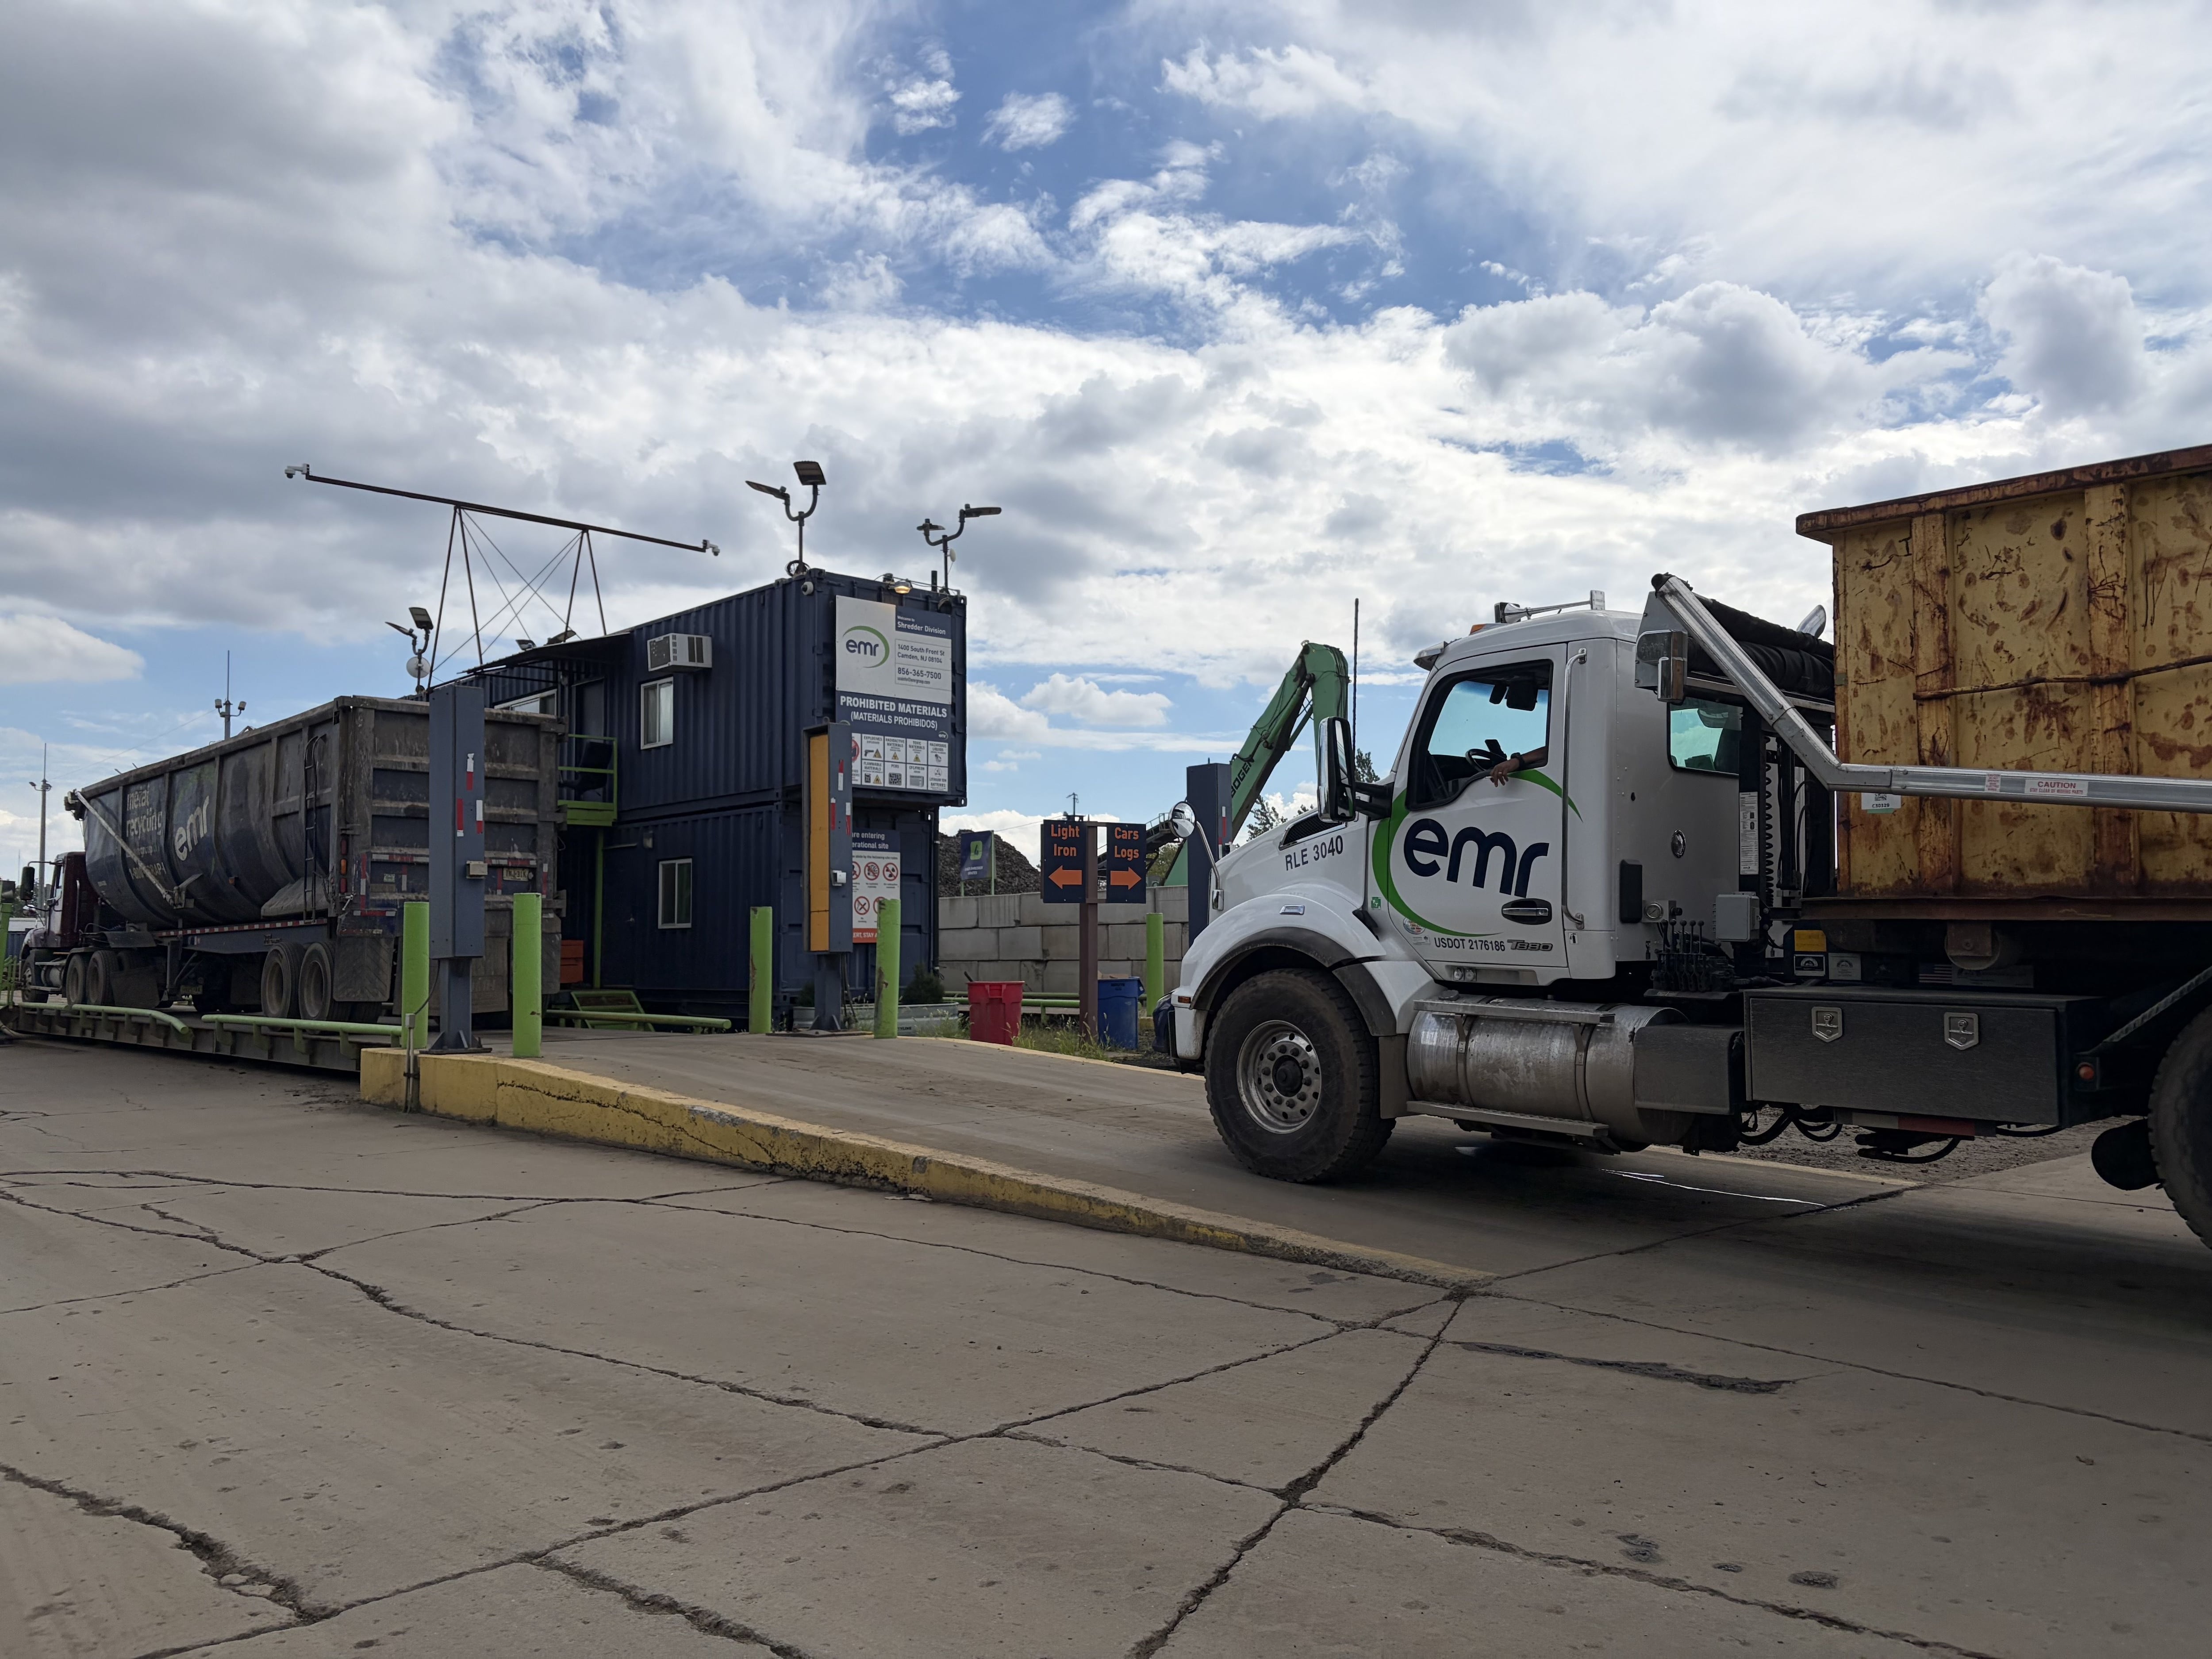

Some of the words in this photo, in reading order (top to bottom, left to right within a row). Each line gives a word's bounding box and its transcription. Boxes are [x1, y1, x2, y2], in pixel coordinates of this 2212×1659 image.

[897, 621, 923, 631] Shredder
[925, 626, 945, 635] Division
[846, 639, 879, 657] emr
[898, 652, 919, 661] Camden,
[898, 667, 941, 679] 856-365-7500
[840, 695, 896, 712] PROHIBITED
[898, 703, 947, 718] MATERIALS
[850, 711, 892, 724] (MATERIALS
[894, 716, 937, 731] PROHIBIDOS)
[127, 807, 163, 840] recycling
[174, 795, 209, 861] emr
[861, 832, 885, 841] entering
[1050, 824, 1080, 840] Light
[1114, 827, 1139, 840] Cars
[1053, 844, 1077, 856] Iron
[1114, 845, 1140, 861] Logs
[1285, 848, 1308, 871] RLE
[1313, 835, 1343, 861] 3040
[1403, 818, 1549, 899] emr
[1434, 937, 1465, 949] USDOT
[1468, 939, 1505, 952] 2176186
[1507, 939, 1553, 951] T880
